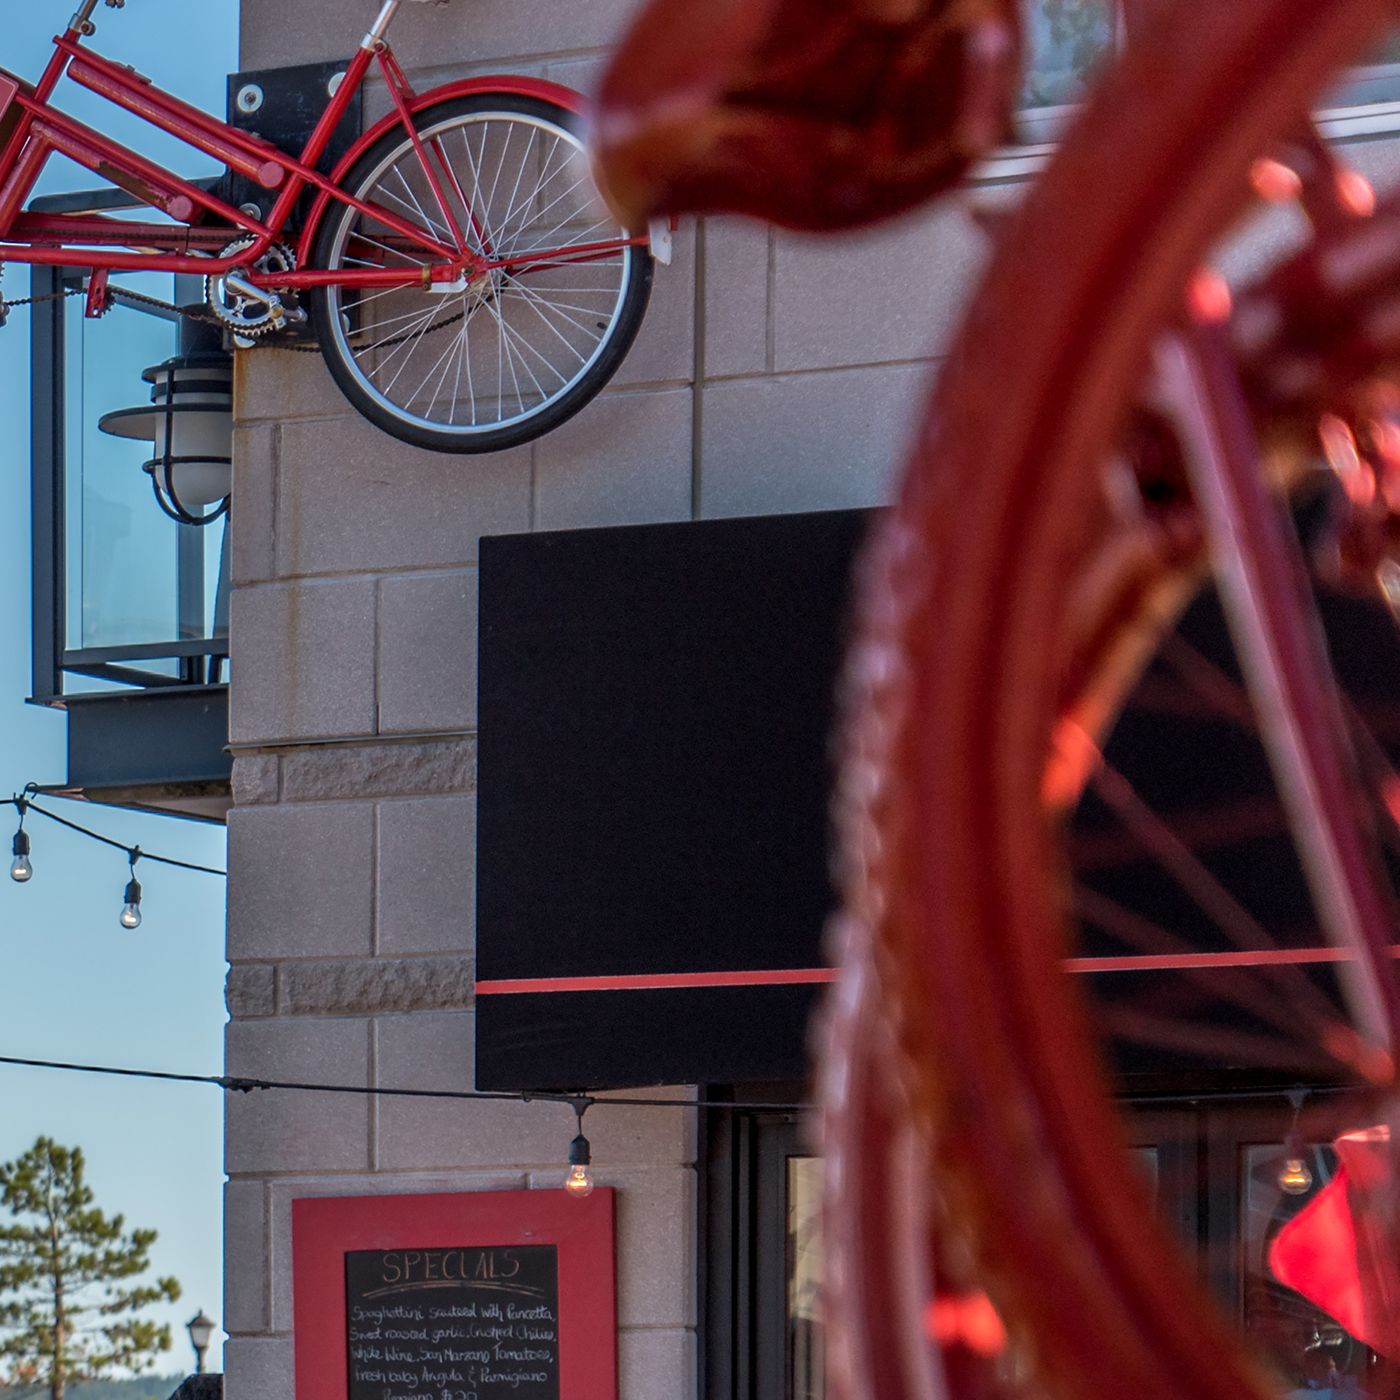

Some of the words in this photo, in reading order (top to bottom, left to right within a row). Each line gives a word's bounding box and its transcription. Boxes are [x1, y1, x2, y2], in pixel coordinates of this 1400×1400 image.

[382, 1249, 520, 1282] SPECIALS
[481, 1303, 504, 1322] with
[420, 1345, 443, 1363] San
[388, 1370, 419, 1388] baby
